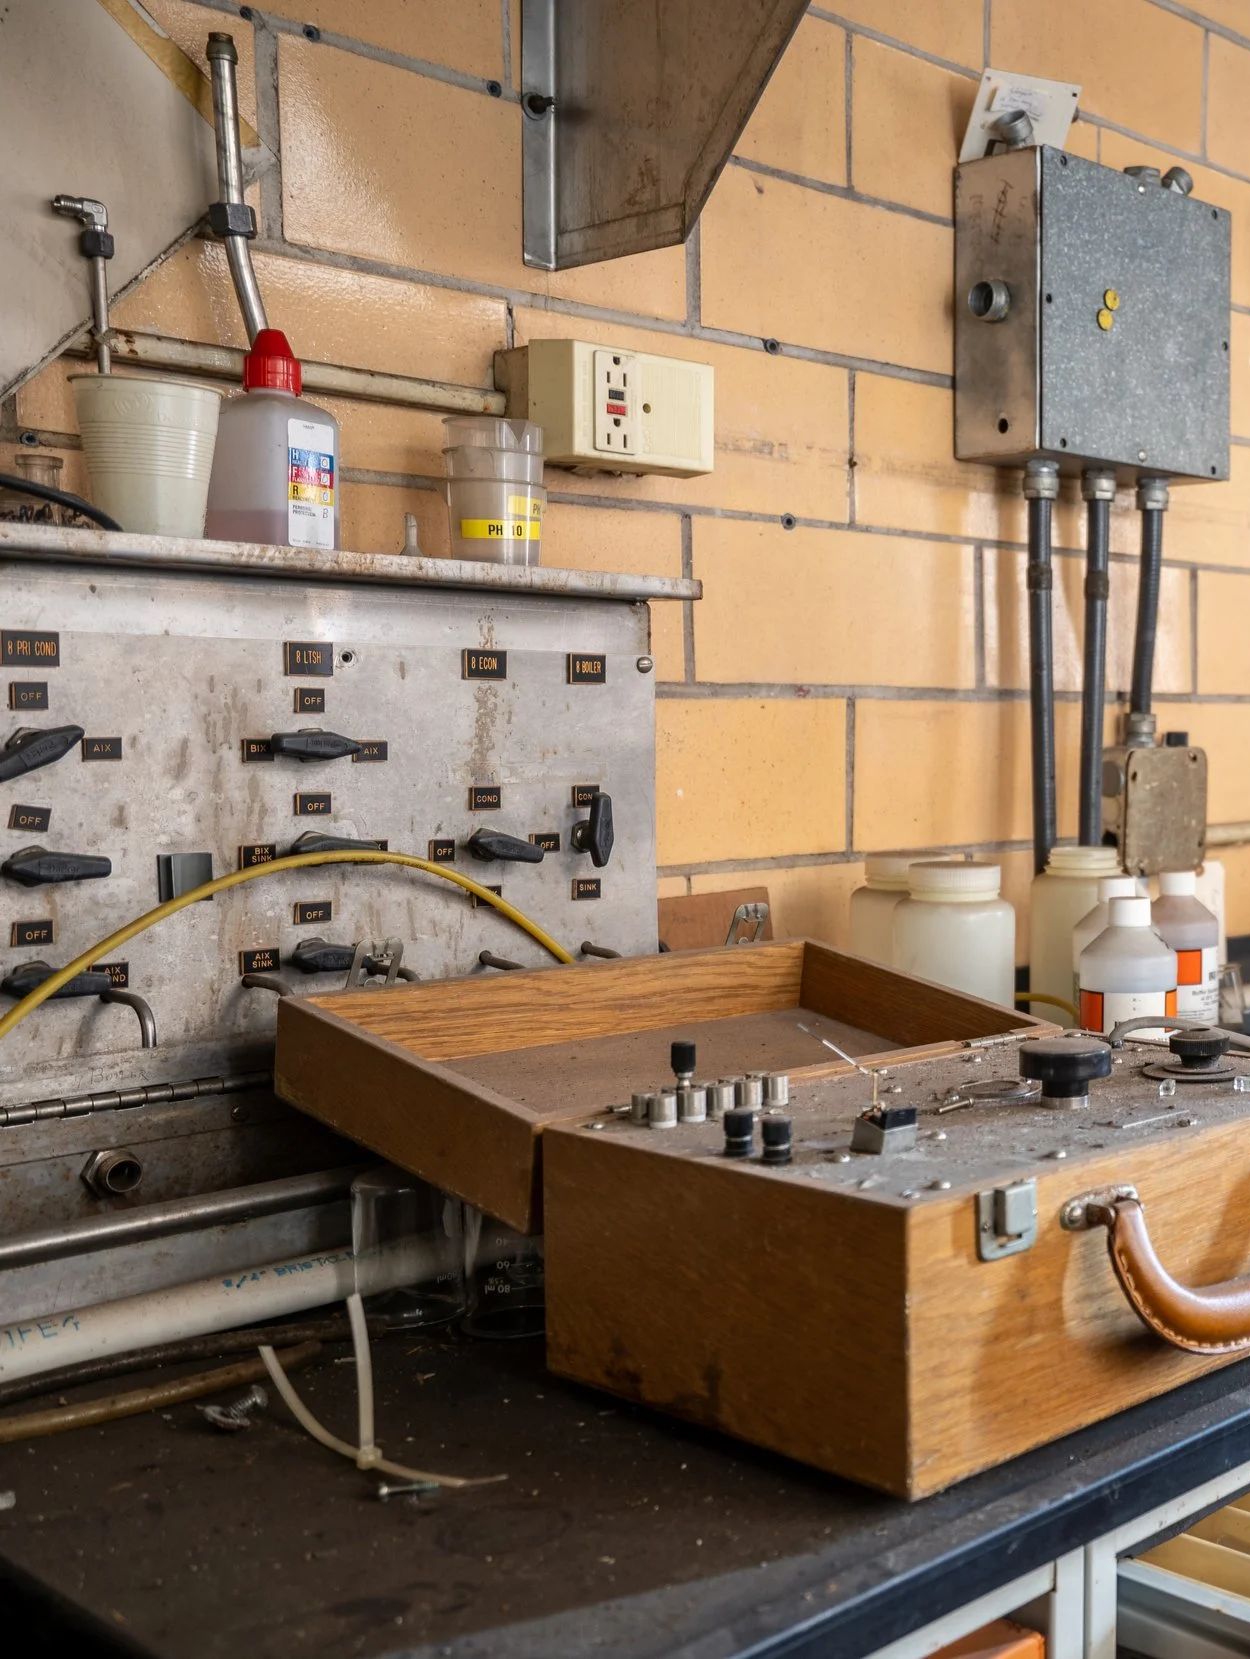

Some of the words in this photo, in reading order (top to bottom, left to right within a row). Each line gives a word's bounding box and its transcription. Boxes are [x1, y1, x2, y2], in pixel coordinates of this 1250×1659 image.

[292, 449, 299, 460] H
[292, 466, 298, 477] F
[292, 485, 299, 495] R
[488, 524, 503, 536] PH
[511, 525, 523, 537] 10
[7, 643, 13, 655] 8
[17, 643, 31, 656] PRI
[35, 643, 57, 657] COND
[296, 650, 301, 663] 8
[304, 650, 322, 664] LTSH
[471, 656, 476, 669] 8
[479, 657, 498, 670] ECON
[576, 661, 581, 673] 8
[582, 661, 602, 674] BOILER
[20, 691, 42, 702] OFF
[304, 697, 322, 705] OFF
[93, 744, 112, 753] AIX
[250, 743, 267, 753] BIX
[363, 747, 379, 756] AIX
[476, 793, 498, 803] COND
[578, 792, 592, 802] CON
[307, 802, 325, 811] OFF
[19, 815, 42, 826] OFF
[540, 840, 555, 849] OFF
[254, 847, 270, 856] BIX
[437, 847, 453, 856] OFF
[251, 854, 273, 863] SINK
[579, 883, 597, 892] SINK
[306, 910, 324, 920] OFF
[25, 930, 48, 941] OFF
[255, 952, 270, 960] AIX
[252, 959, 273, 968] SINK
[105, 967, 121, 975] AIX
[112, 973, 126, 983] ND
[498, 1283, 511, 1294] 80
